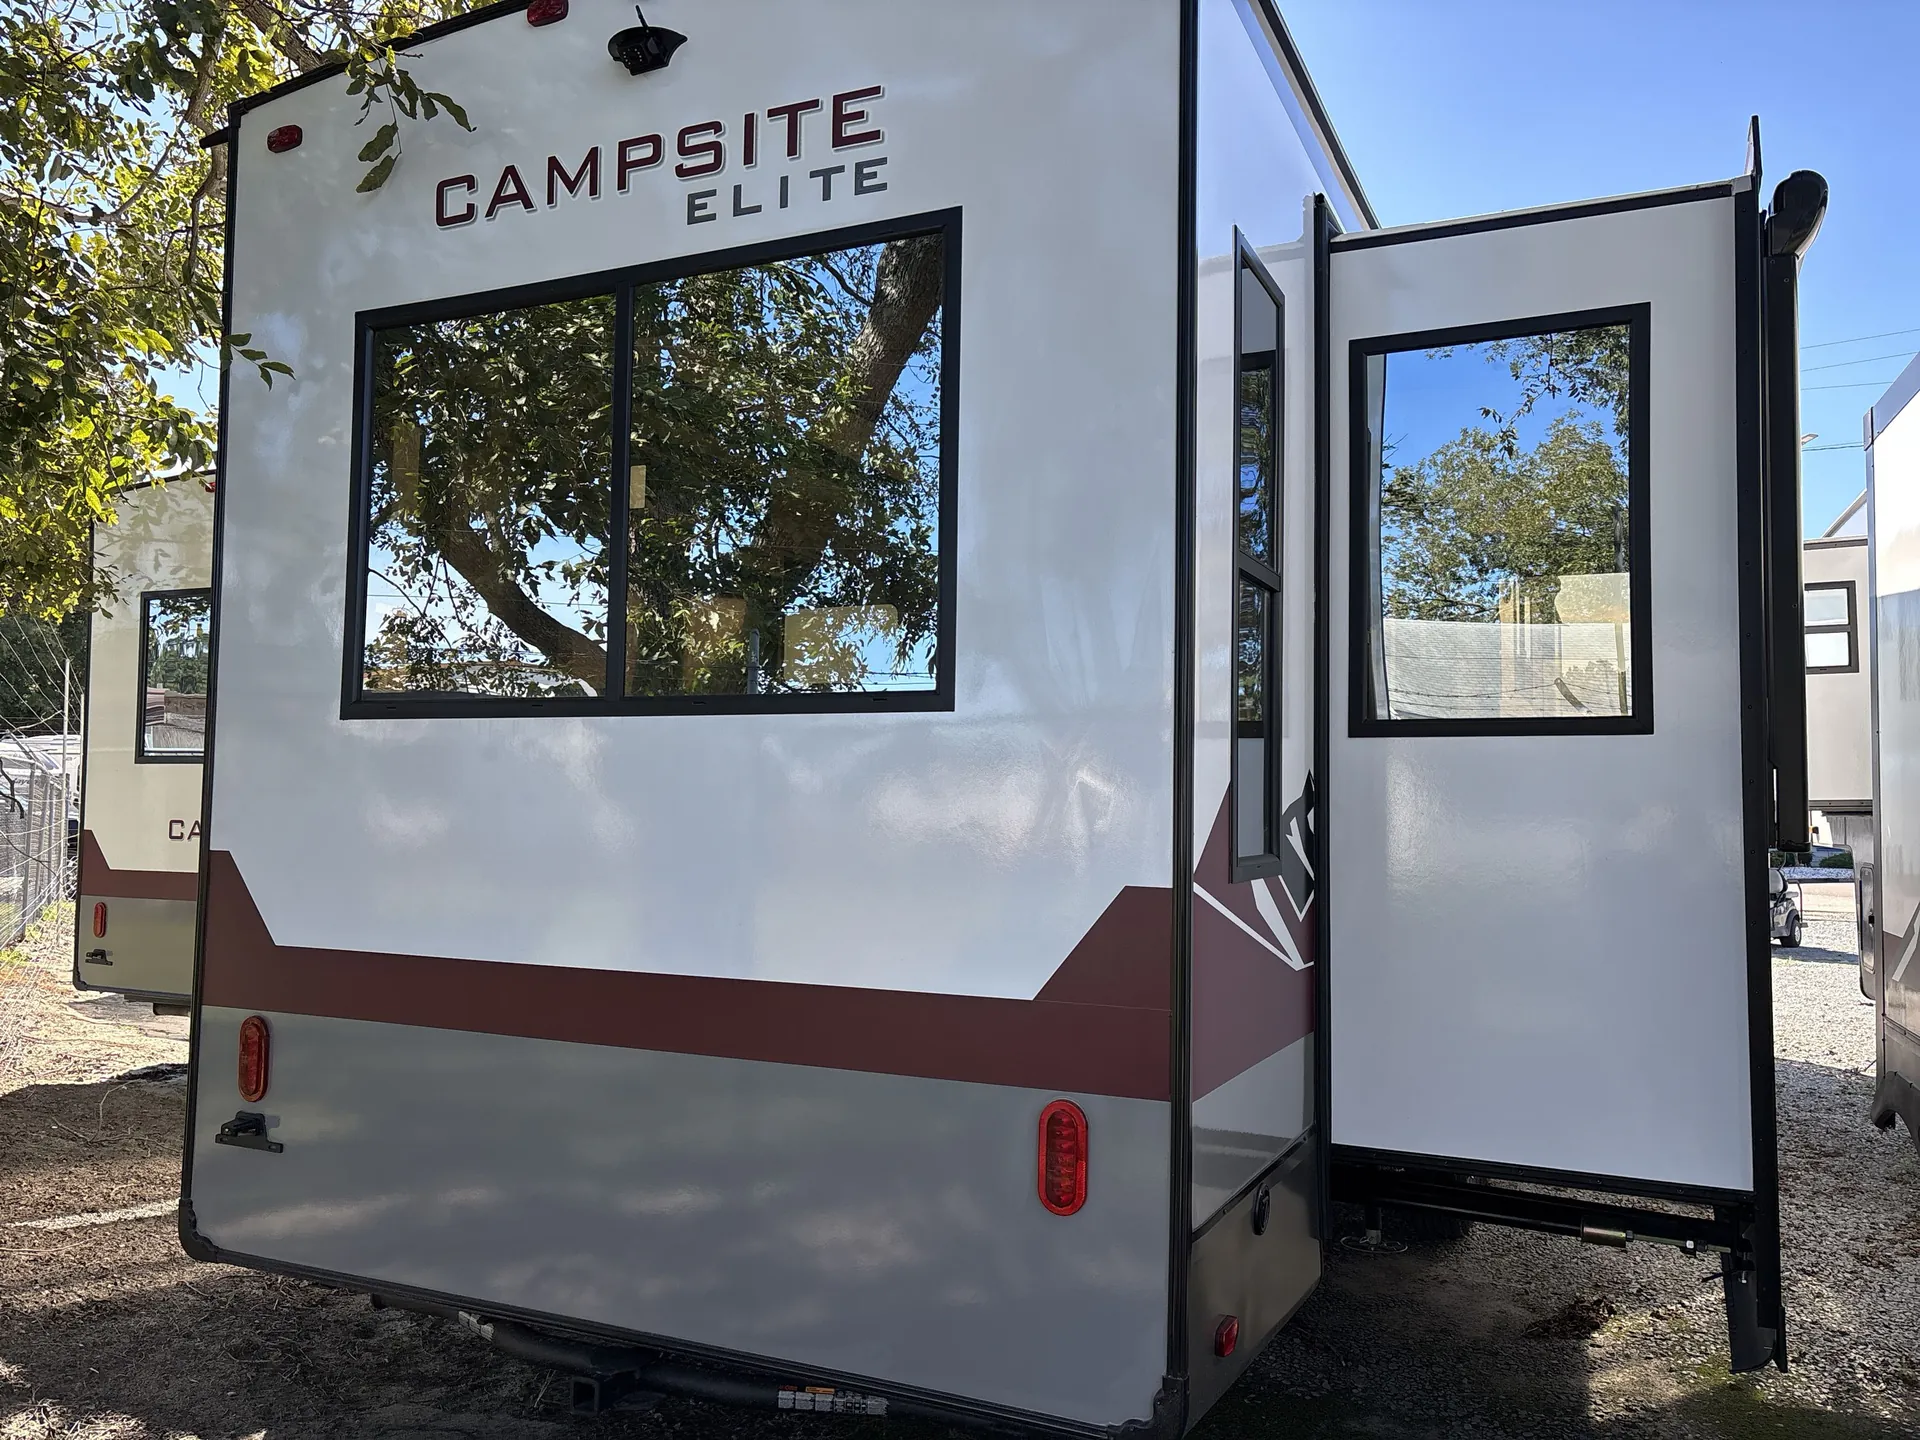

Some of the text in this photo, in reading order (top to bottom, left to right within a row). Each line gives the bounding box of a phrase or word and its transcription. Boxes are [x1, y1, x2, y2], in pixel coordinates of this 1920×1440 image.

[436, 85, 885, 228] CAMPSITE
[687, 157, 888, 225] ELITE
[168, 819, 201, 840] CA
